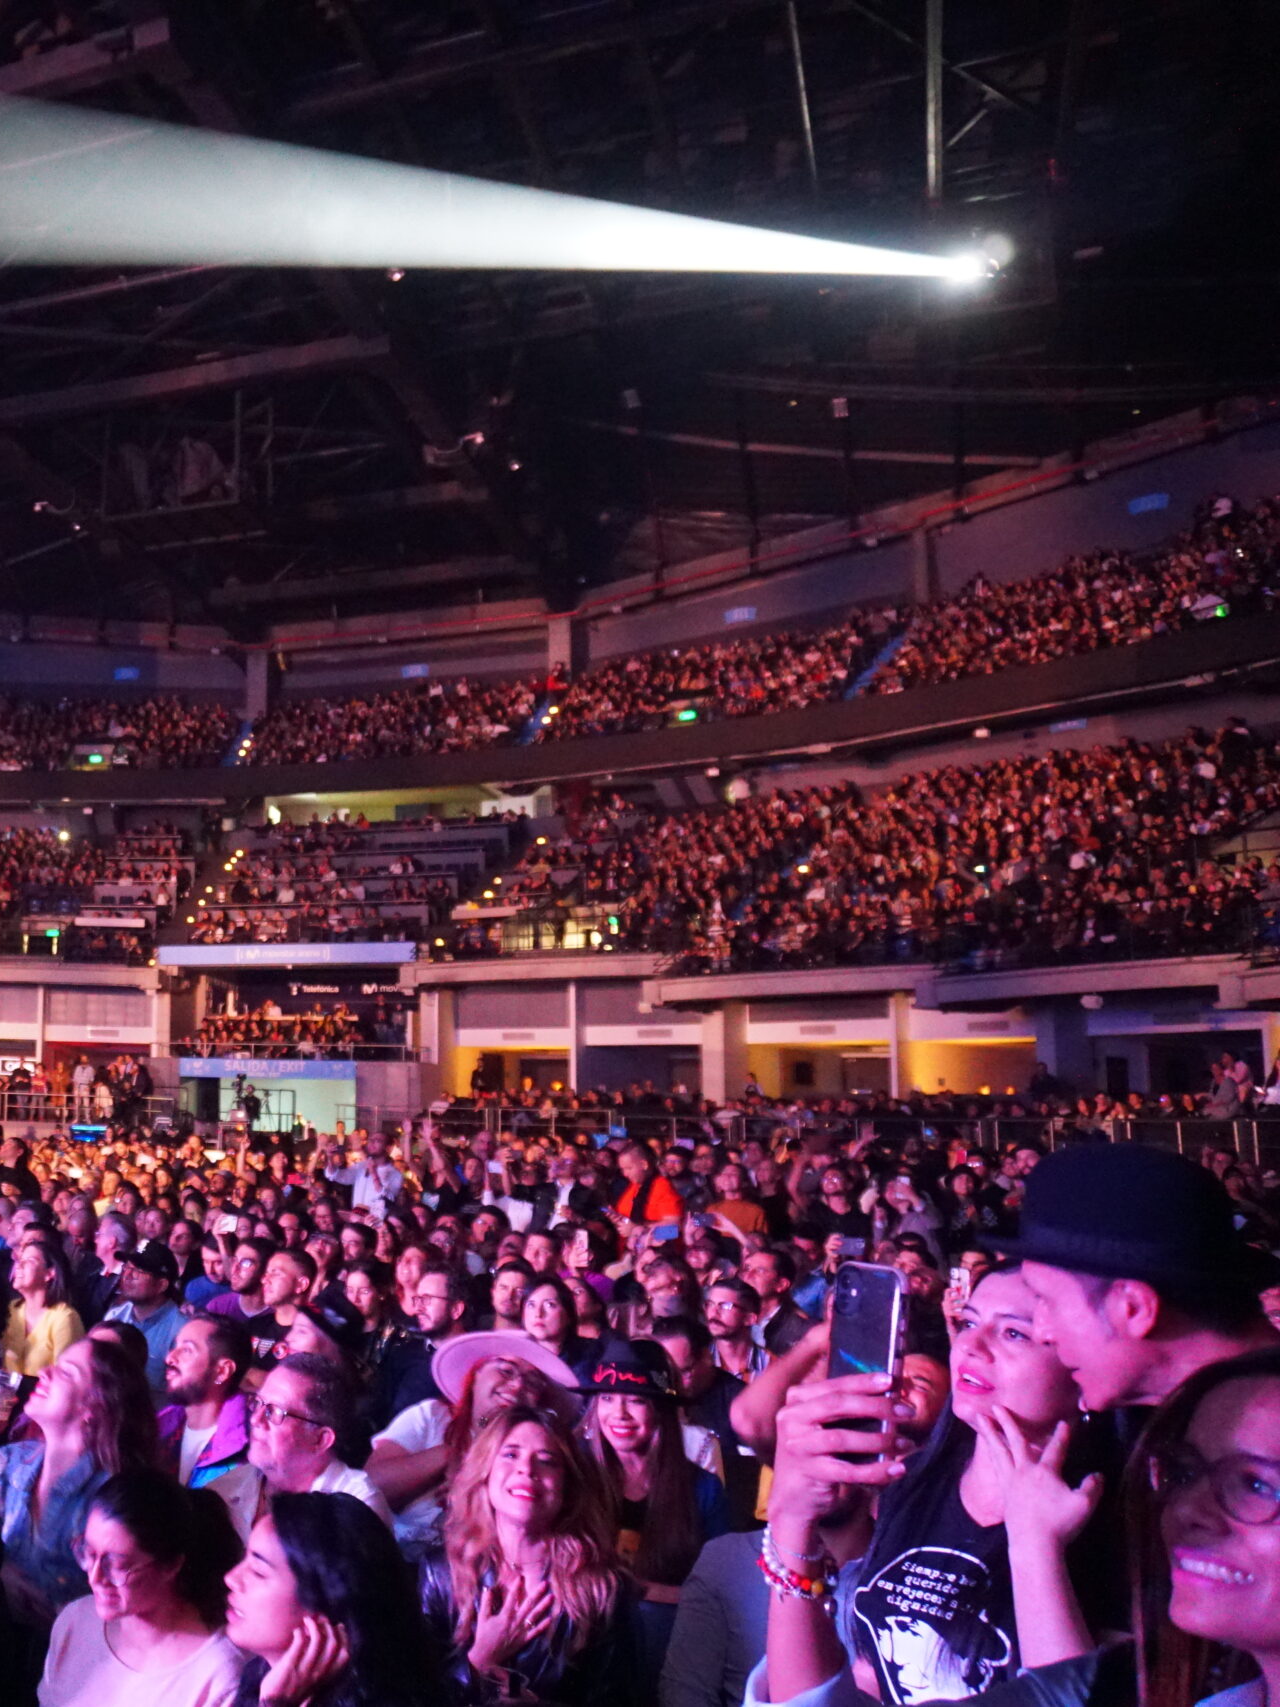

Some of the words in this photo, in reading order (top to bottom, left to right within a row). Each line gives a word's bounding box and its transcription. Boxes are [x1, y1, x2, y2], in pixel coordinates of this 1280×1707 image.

[224, 1060, 269, 1073] SALIDA
[279, 1060, 306, 1073] EXIT
[877, 1579, 947, 1605] envejecer
[904, 1575, 960, 1595] querido
